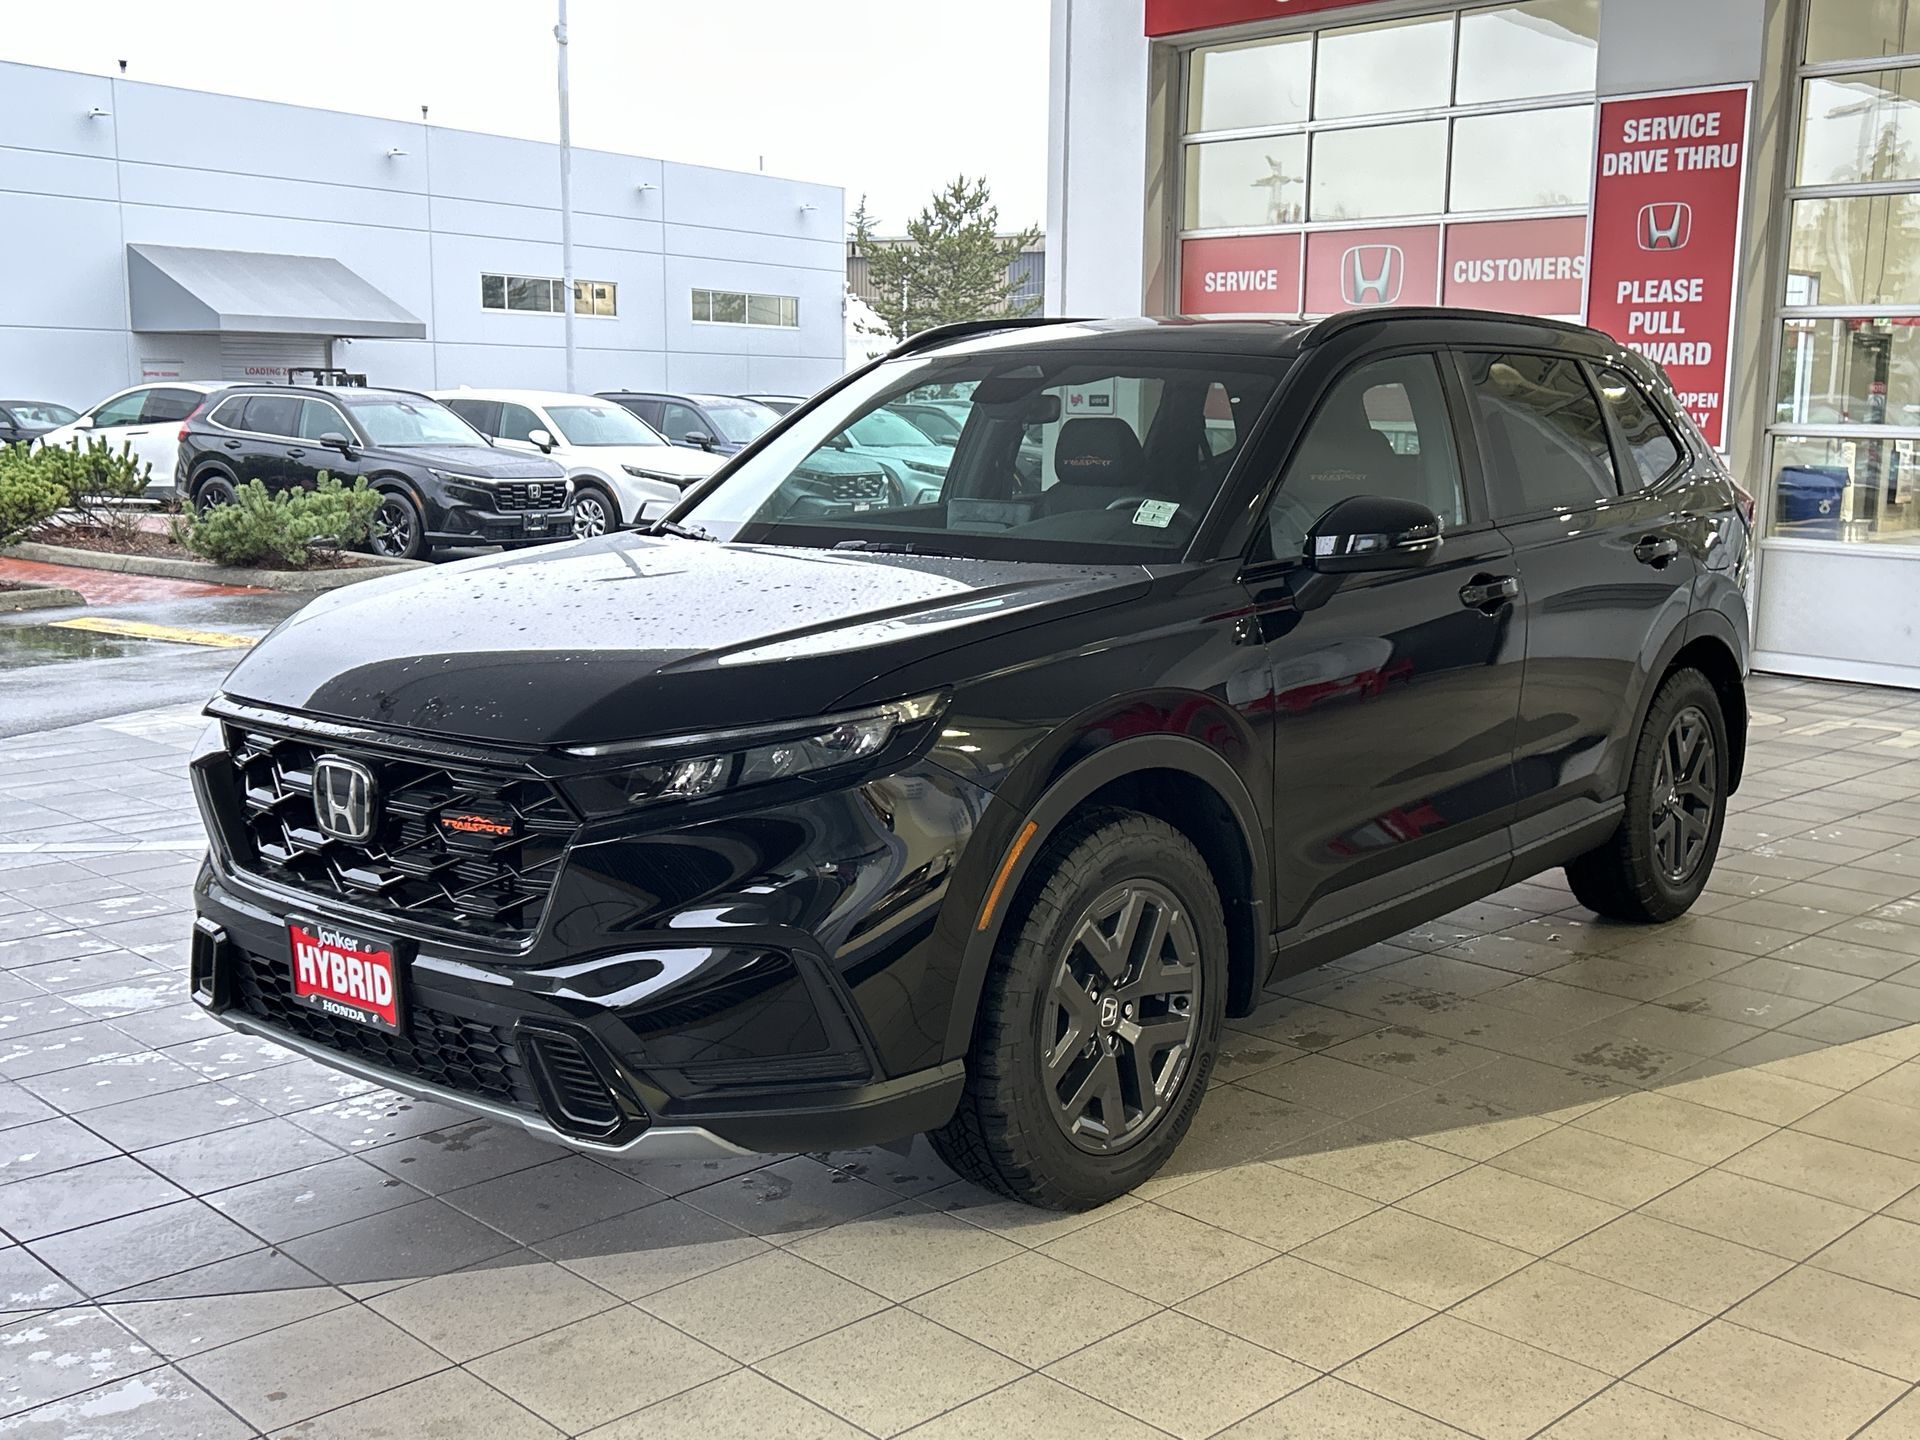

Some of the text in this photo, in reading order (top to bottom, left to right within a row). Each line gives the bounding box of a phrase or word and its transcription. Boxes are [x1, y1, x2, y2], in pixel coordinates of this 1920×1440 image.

[1623, 112, 1720, 143] SERVICE
[1602, 143, 1738, 176] DRIVE THRU
[1204, 256, 1585, 293] SERVICE CUSTOMERS
[1617, 278, 1704, 304] PLEASE
[1628, 310, 1686, 335] PULL
[245, 367, 281, 376] LOADING
[1678, 392, 1719, 409] OPEN
[441, 818, 512, 835] TRAILSPORT
[317, 926, 358, 953] Jonker
[296, 942, 393, 1007] HYBRID
[322, 999, 367, 1023] HONDA
